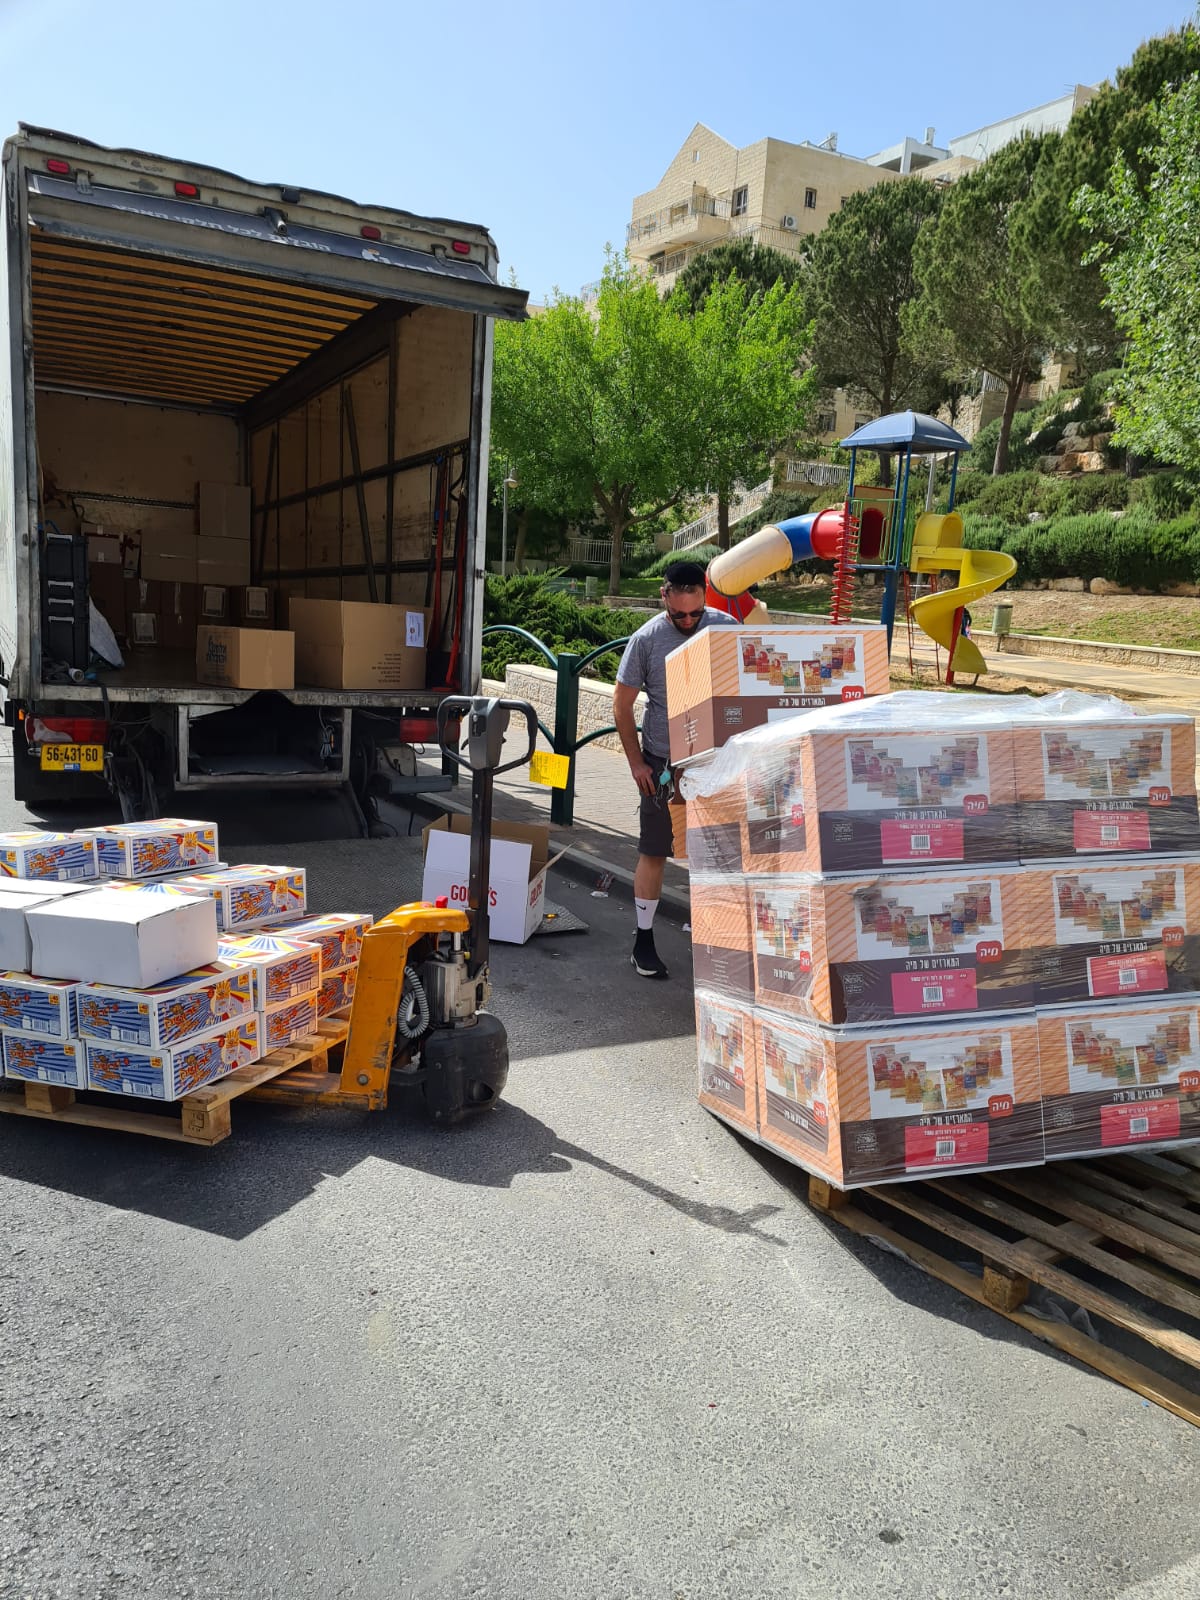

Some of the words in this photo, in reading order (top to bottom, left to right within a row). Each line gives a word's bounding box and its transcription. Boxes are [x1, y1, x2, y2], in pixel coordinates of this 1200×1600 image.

[174, 214, 224, 230] חלקי
[227, 224, 262, 237] לכל
[844, 691, 861, 699] מיה
[967, 801, 985, 810] מיה
[980, 947, 999, 957] מיה
[905, 960, 918, 971] מיה
[919, 959, 930, 970] של
[932, 957, 960, 969] המארזים
[992, 1100, 1010, 1112] מיה
[933, 1115, 943, 1126] של
[945, 1112, 973, 1126] המארזים
